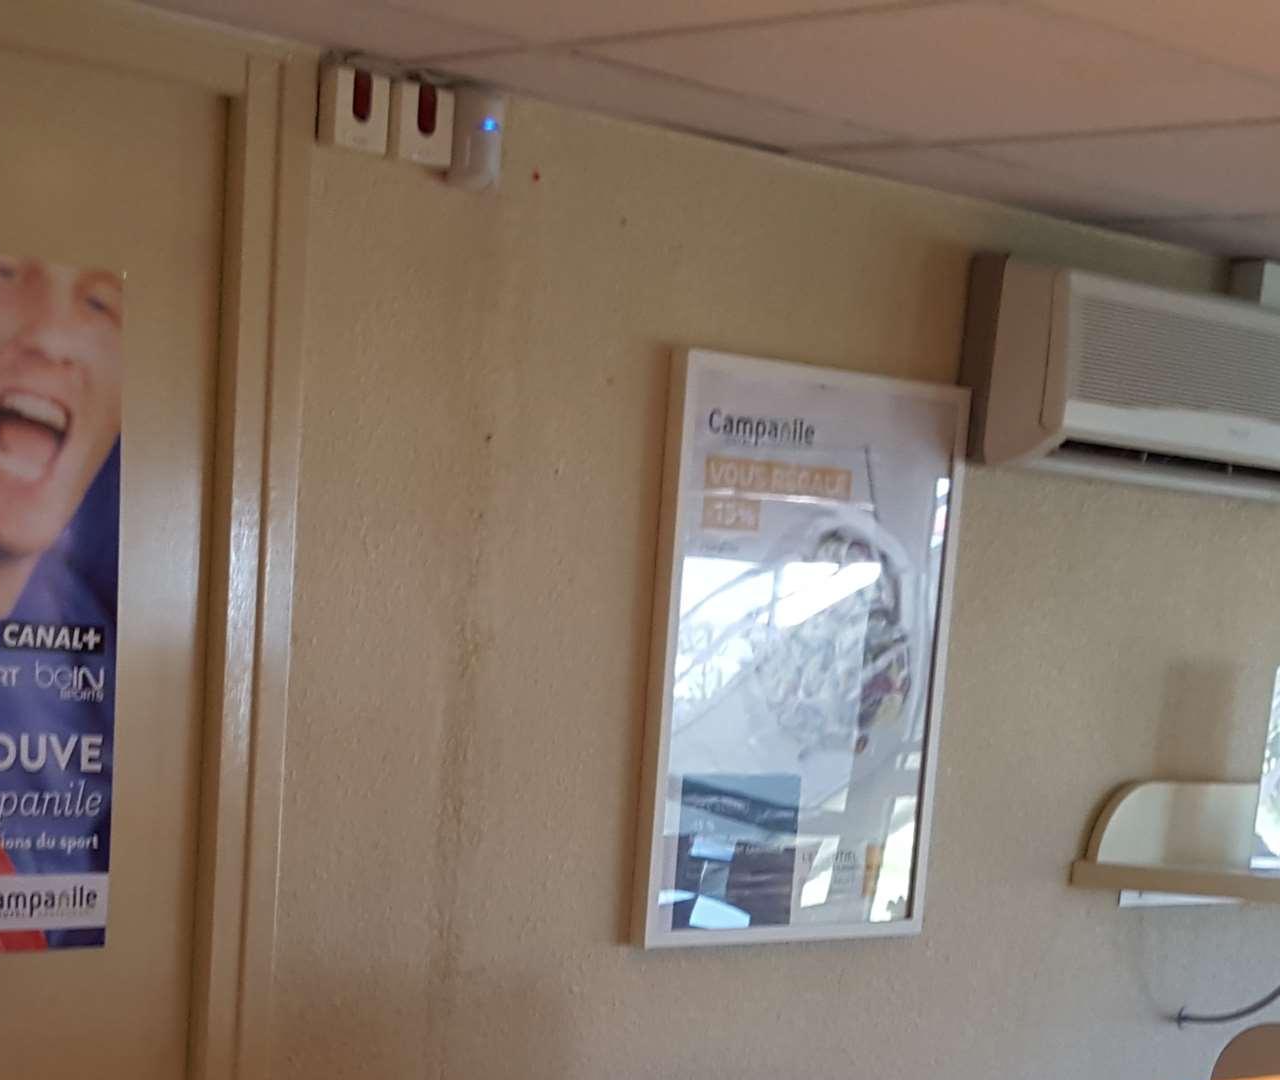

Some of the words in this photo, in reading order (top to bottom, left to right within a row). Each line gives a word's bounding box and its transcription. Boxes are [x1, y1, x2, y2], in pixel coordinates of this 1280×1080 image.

[708, 407, 816, 446] Campanile
[2, 622, 102, 650] CANAL+
[35, 832, 57, 849] du
[59, 831, 100, 856] sport
